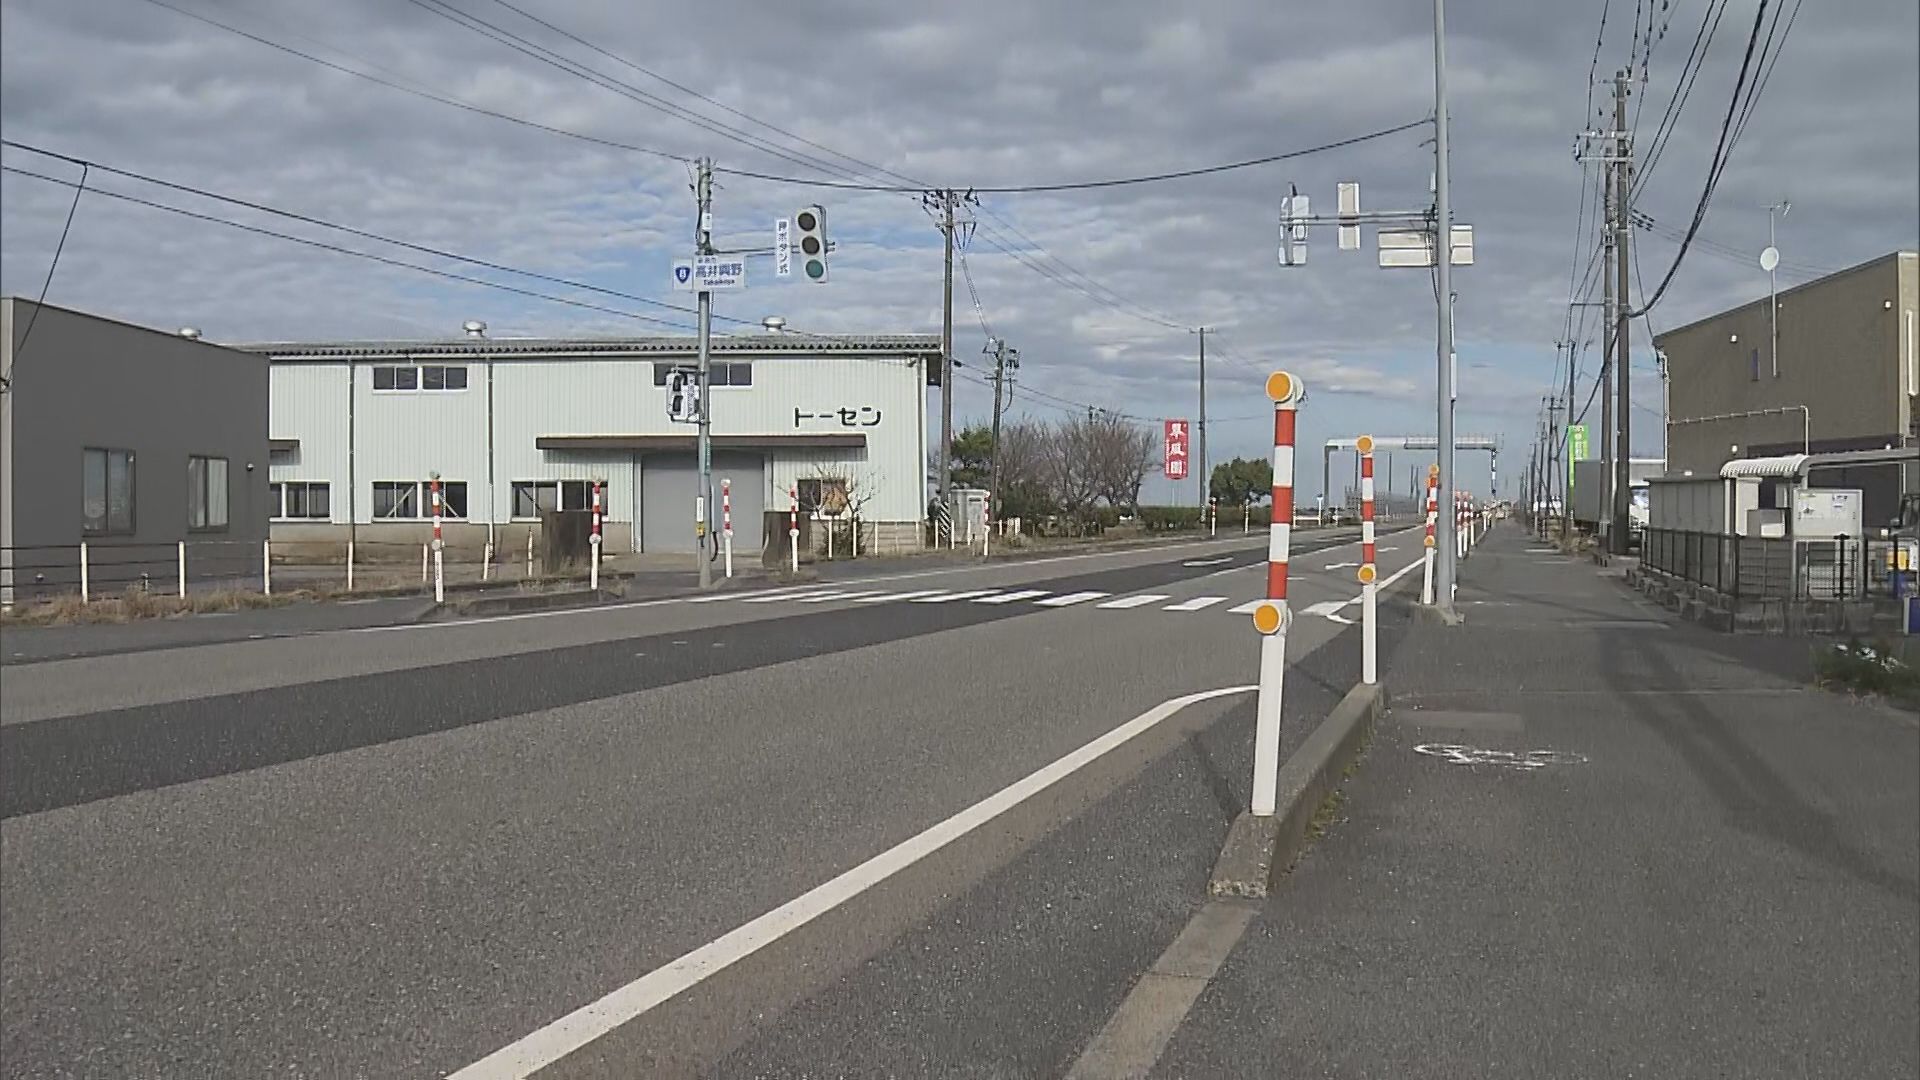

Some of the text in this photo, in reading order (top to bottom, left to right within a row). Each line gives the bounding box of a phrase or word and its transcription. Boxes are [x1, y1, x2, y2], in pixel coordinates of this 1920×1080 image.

[777, 221, 789, 275] 押ボタン式
[695, 263, 743, 278] 高井興野
[795, 407, 882, 428] トーセン
